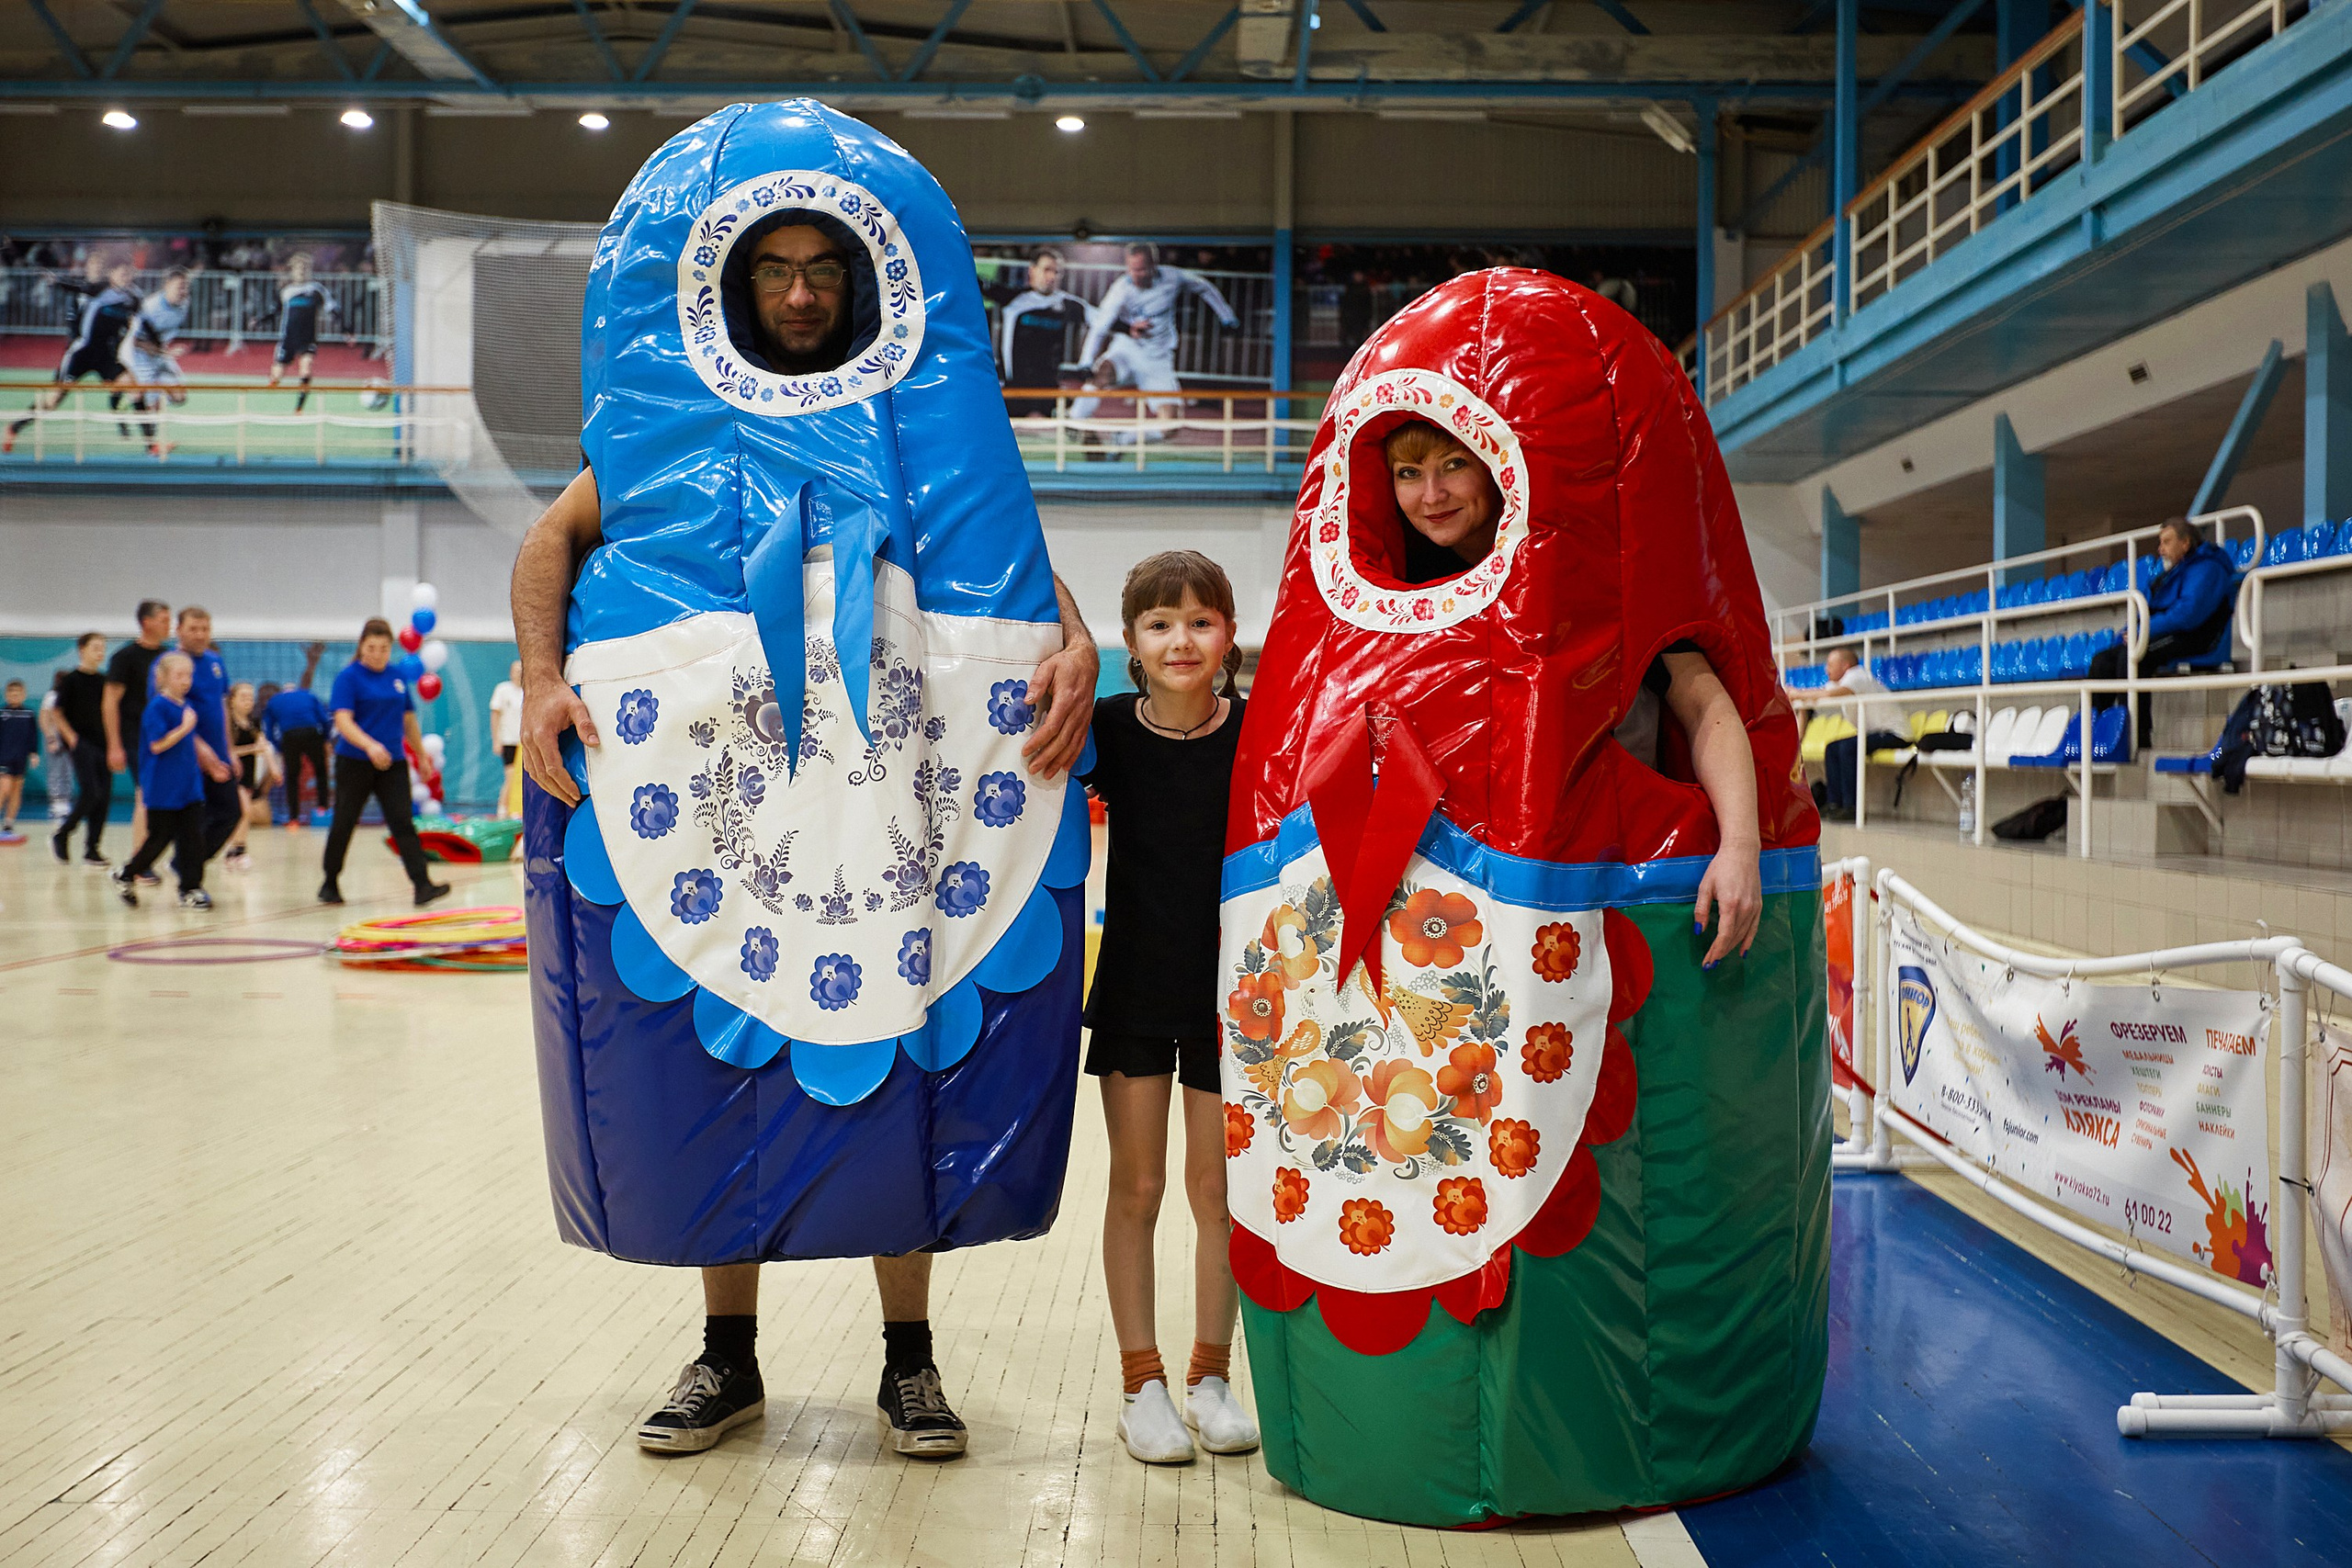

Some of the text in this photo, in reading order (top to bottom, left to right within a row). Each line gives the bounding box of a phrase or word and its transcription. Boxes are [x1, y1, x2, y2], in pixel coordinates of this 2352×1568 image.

[2110, 1021, 2188, 1044] ФРЕЗЕРУЕМ
[2206, 1028, 2256, 1056] ПЕЧАТАЕМ
[2074, 1092, 2121, 1115] РЕКЛАМЫ
[2196, 1101, 2232, 1119] БАННЕРЫ
[2003, 1117, 2039, 1145] fsjunior.com
[2061, 1104, 2120, 1150] КЛЯКСА
[2198, 1120, 2235, 1140] НАКЛЕЙКИ
[2124, 1198, 2172, 1234] 61 00 22
